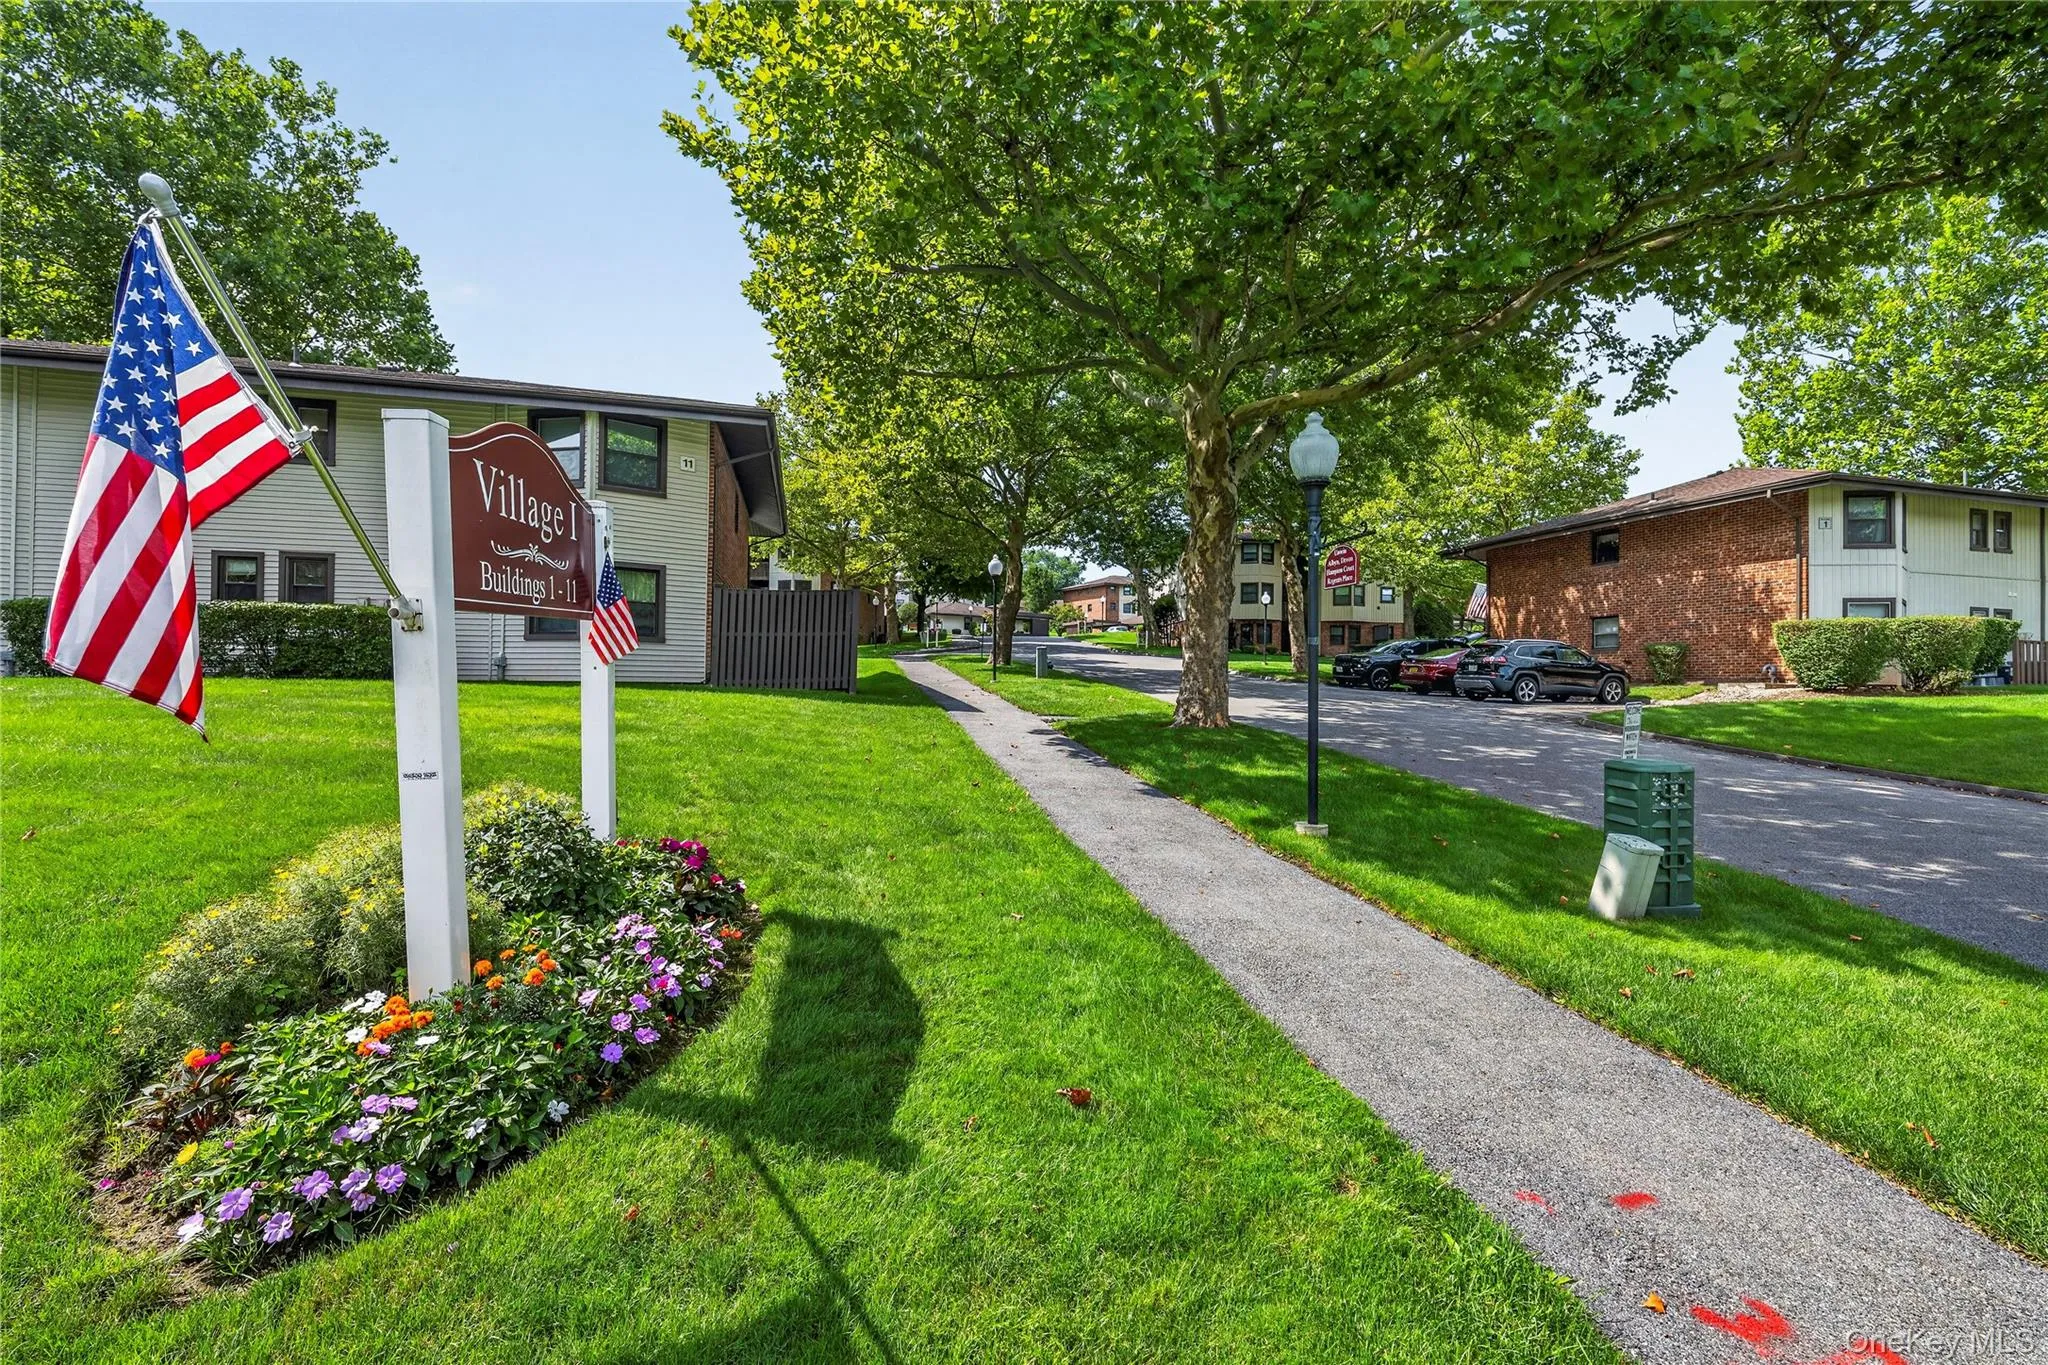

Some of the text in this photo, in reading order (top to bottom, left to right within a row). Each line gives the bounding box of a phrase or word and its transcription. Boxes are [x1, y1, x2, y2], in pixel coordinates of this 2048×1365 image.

[681, 459, 693, 469] 11
[472, 457, 578, 544] Village I
[479, 560, 546, 605] Buildings
[549, 575, 555, 600] 1
[566, 579, 577, 603] 11
